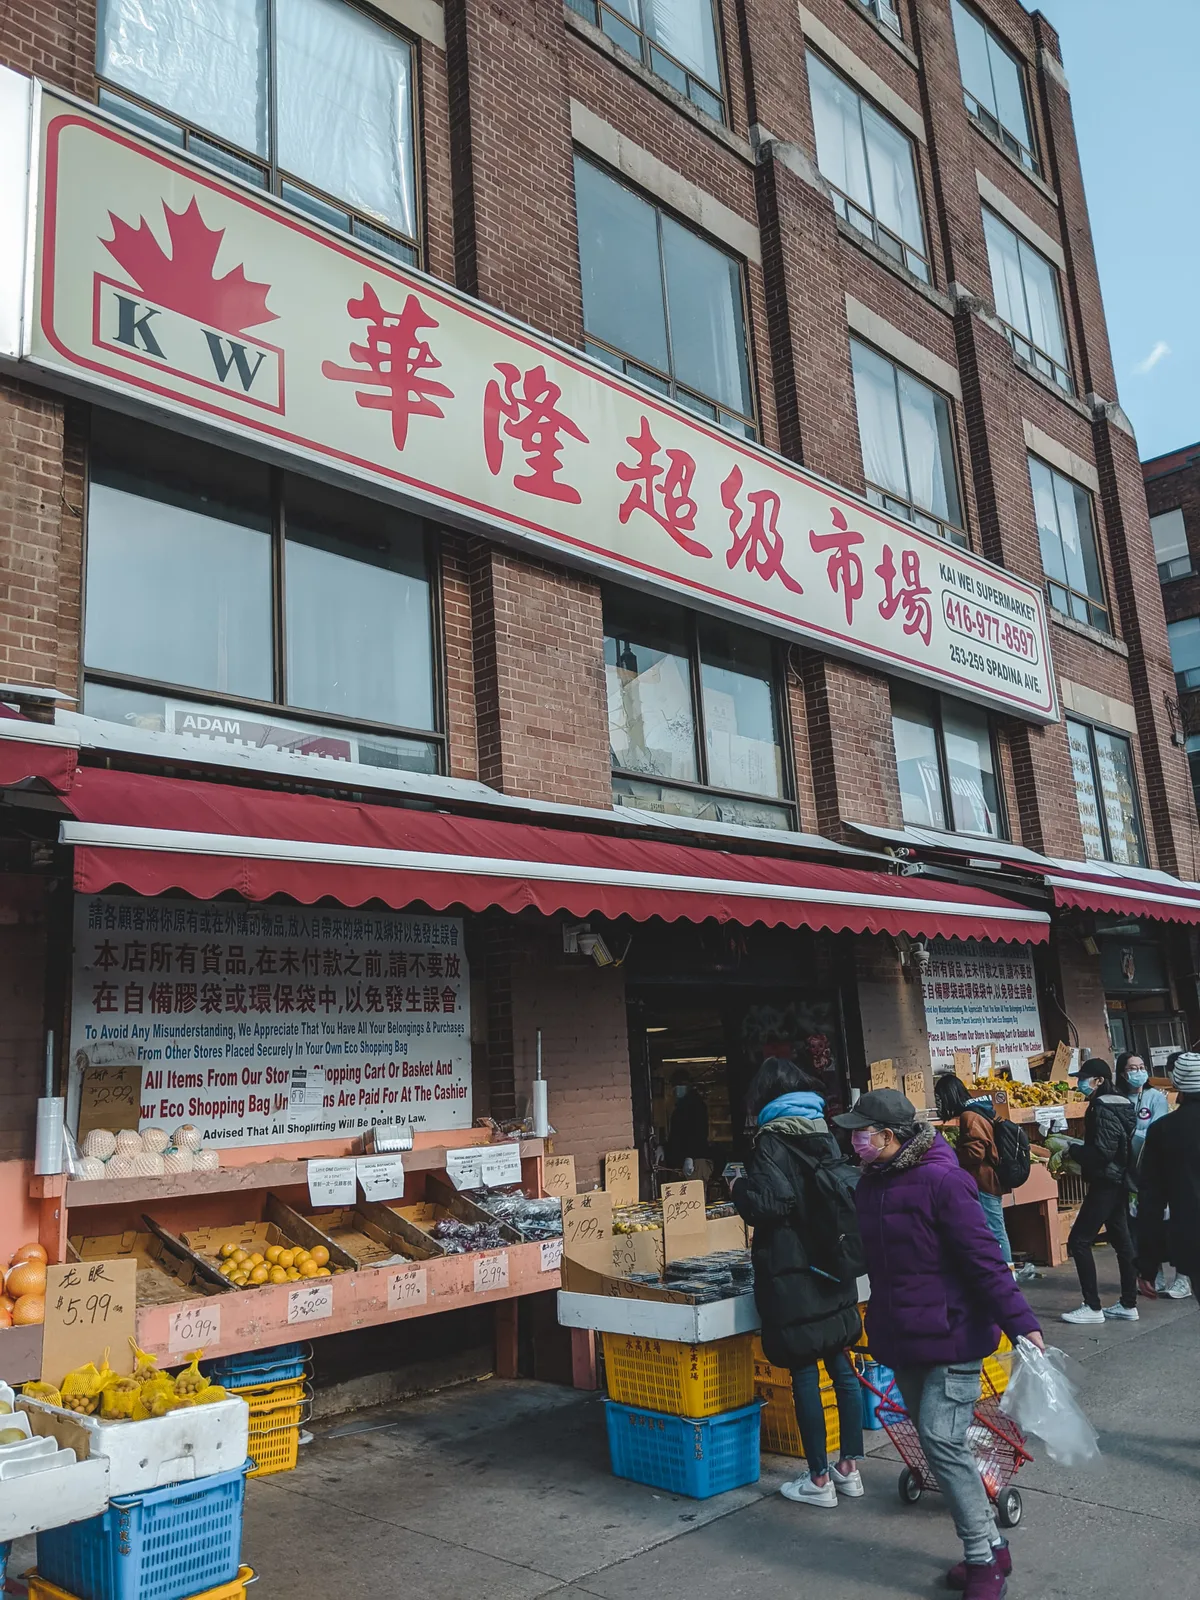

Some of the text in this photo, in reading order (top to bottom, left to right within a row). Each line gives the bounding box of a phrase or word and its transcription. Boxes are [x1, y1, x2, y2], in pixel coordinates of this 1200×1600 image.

[938, 563, 1036, 623] KAI WEI SUPERMARKET
[946, 597, 1034, 659] 416-977-8597
[949, 644, 1042, 695] 253-259 SPADINA AVE.
[183, 715, 241, 735] ADAM
[85, 1021, 465, 1042] To Avoid Any Misunderstanding, We Appreciate That You Have All Your Belongings & Purchases
[928, 1032, 939, 1041] Place
[946, 1032, 957, 1040] Items
[958, 1031, 967, 1040] From
[974, 1031, 985, 1039] Store
[985, 1031, 989, 1039] In
[989, 1030, 1005, 1041] Shopping
[1012, 1030, 1017, 1038] Or
[1017, 1029, 1028, 1038] Basket
[138, 1040, 408, 1060] From Other Stores Placed Securely In Your Own Eco Shopping Bag
[936, 1047, 945, 1057] Your
[1030, 1042, 1042, 1051] Cashier
[145, 1071, 162, 1089] All
[167, 1070, 203, 1088] Items
[207, 1068, 237, 1087] From
[241, 1067, 262, 1085] Our
[266, 1065, 289, 1084] Stor
[364, 1063, 385, 1079] Cart
[389, 1062, 399, 1078] Or
[402, 1061, 433, 1078] Basket
[435, 1060, 452, 1075] And
[160, 1099, 184, 1117] Eco
[188, 1096, 245, 1120] Shopping
[248, 1093, 270, 1115] Bag
[337, 1090, 355, 1107] Are
[359, 1088, 379, 1106] Paid
[383, 1087, 399, 1103] For
[400, 1086, 412, 1102] At
[414, 1085, 432, 1101] The
[434, 1083, 467, 1100] Cashier
[203, 1127, 243, 1140] Advised
[246, 1126, 269, 1137] That
[271, 1125, 284, 1136] All
[338, 1119, 354, 1130] Will
[357, 1117, 368, 1127] Be
[371, 1116, 393, 1126] Dealt
[396, 1115, 406, 1126] By
[408, 1114, 427, 1123] Law.
[55, 1294, 112, 1325] $5.99
